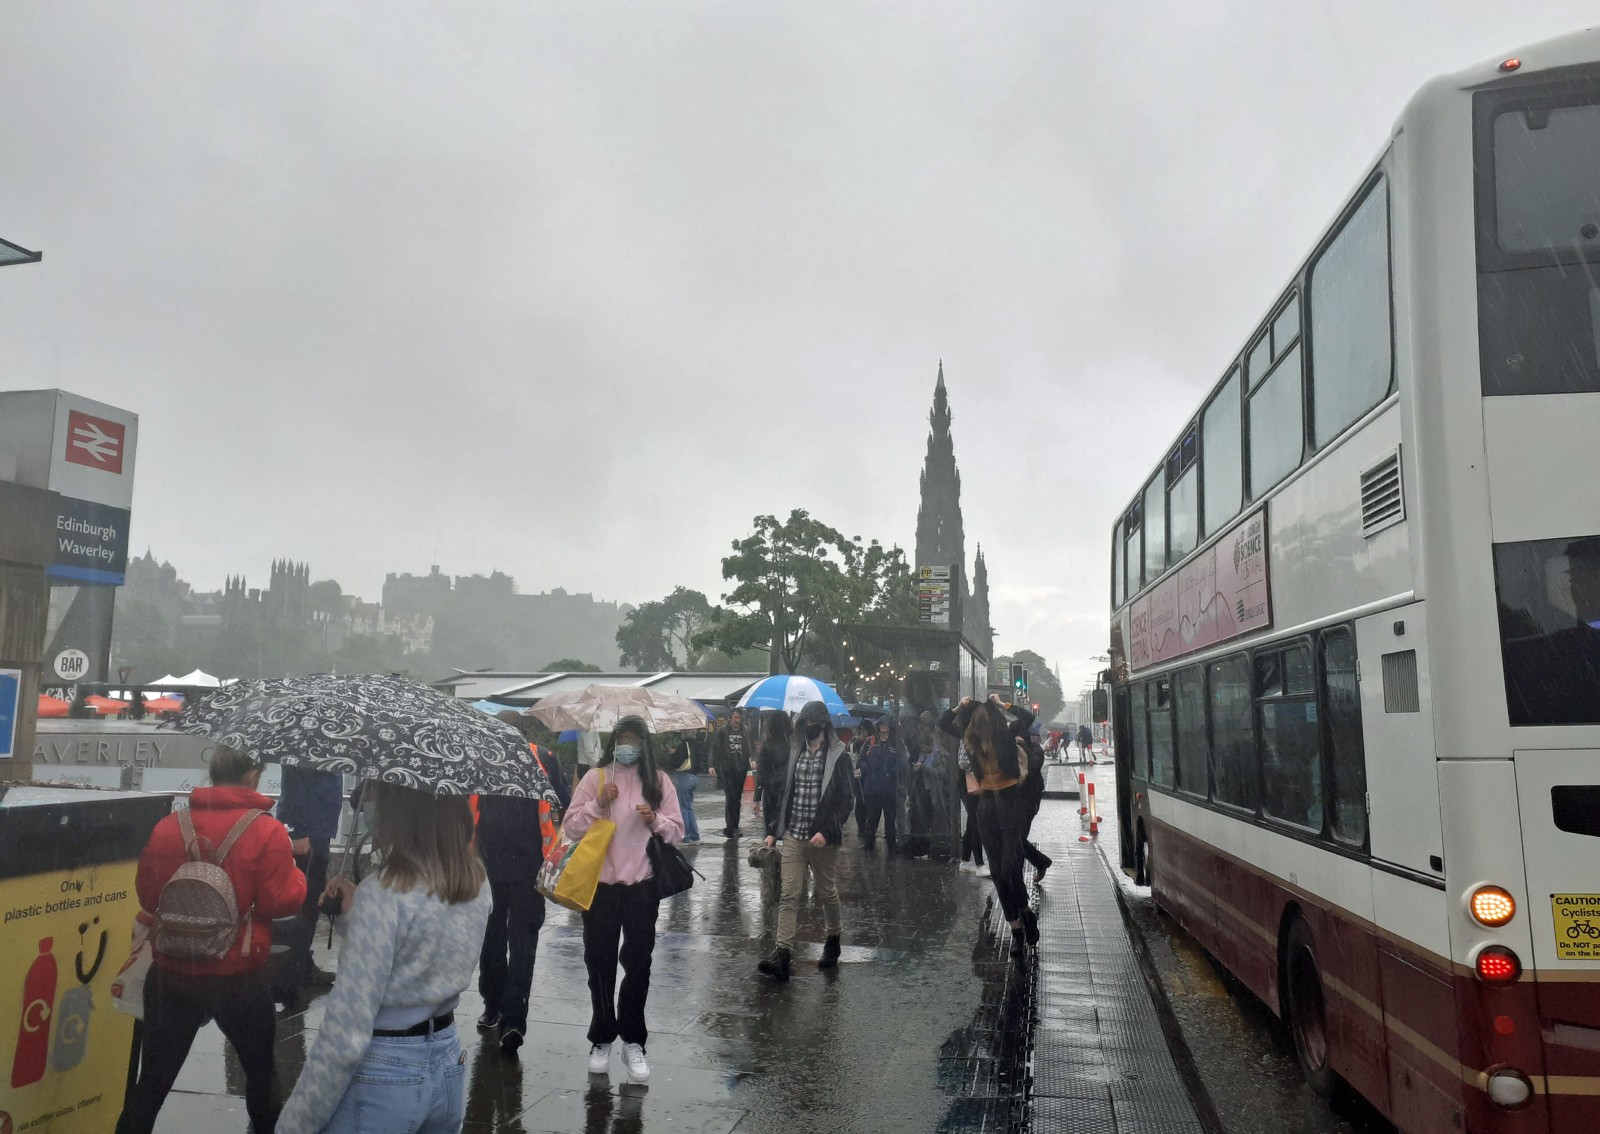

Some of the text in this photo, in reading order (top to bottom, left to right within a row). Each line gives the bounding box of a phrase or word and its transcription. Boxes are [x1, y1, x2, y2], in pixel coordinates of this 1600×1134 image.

[56, 514, 116, 541] Edinburgh
[58, 537, 115, 563] Waverley
[1240, 533, 1262, 562] SCIENCE
[921, 569, 932, 578] PP
[60, 656, 83, 673] BAR
[32, 740, 168, 763] AVERLEY
[60, 878, 84, 893] Only
[4, 889, 128, 924] plastic bottles and cans
[1561, 908, 1600, 919] Cyclists
[1559, 941, 1571, 949] Do
[1573, 941, 1591, 949] NOT
[1577, 949, 1591, 957] the
